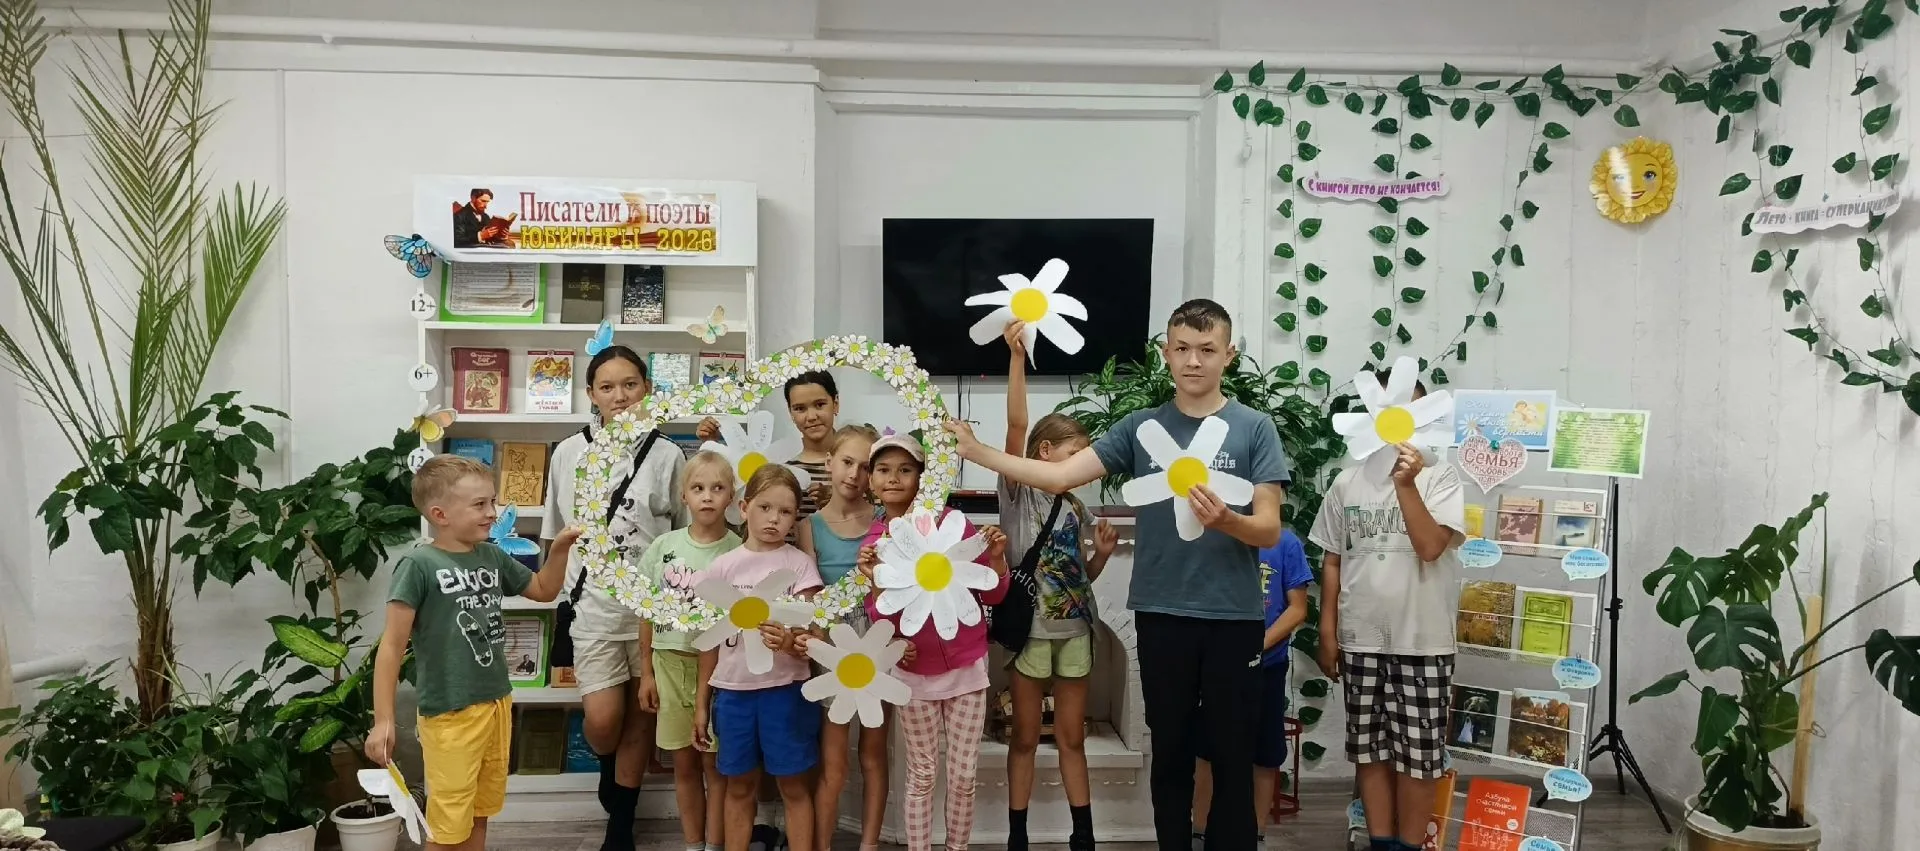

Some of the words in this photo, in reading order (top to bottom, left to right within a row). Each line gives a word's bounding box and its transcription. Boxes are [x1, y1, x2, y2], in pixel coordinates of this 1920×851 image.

[1351, 183, 1376, 195] ЛЕТО
[1377, 185, 1389, 196] НЕ
[1391, 181, 1441, 194] КОНЧАЕТСЯ!
[519, 191, 621, 223] Писатели
[626, 202, 641, 225] и
[646, 202, 712, 225] поэты
[1795, 208, 1819, 224] КНИГА
[520, 225, 641, 251] ЮБИЛЯРЫ
[655, 228, 714, 251] 2026
[410, 298, 436, 313] 12+
[414, 369, 433, 380] 6+
[1465, 447, 1519, 468] Семья
[436, 566, 499, 594] ENJOY
[456, 594, 482, 609] THE
